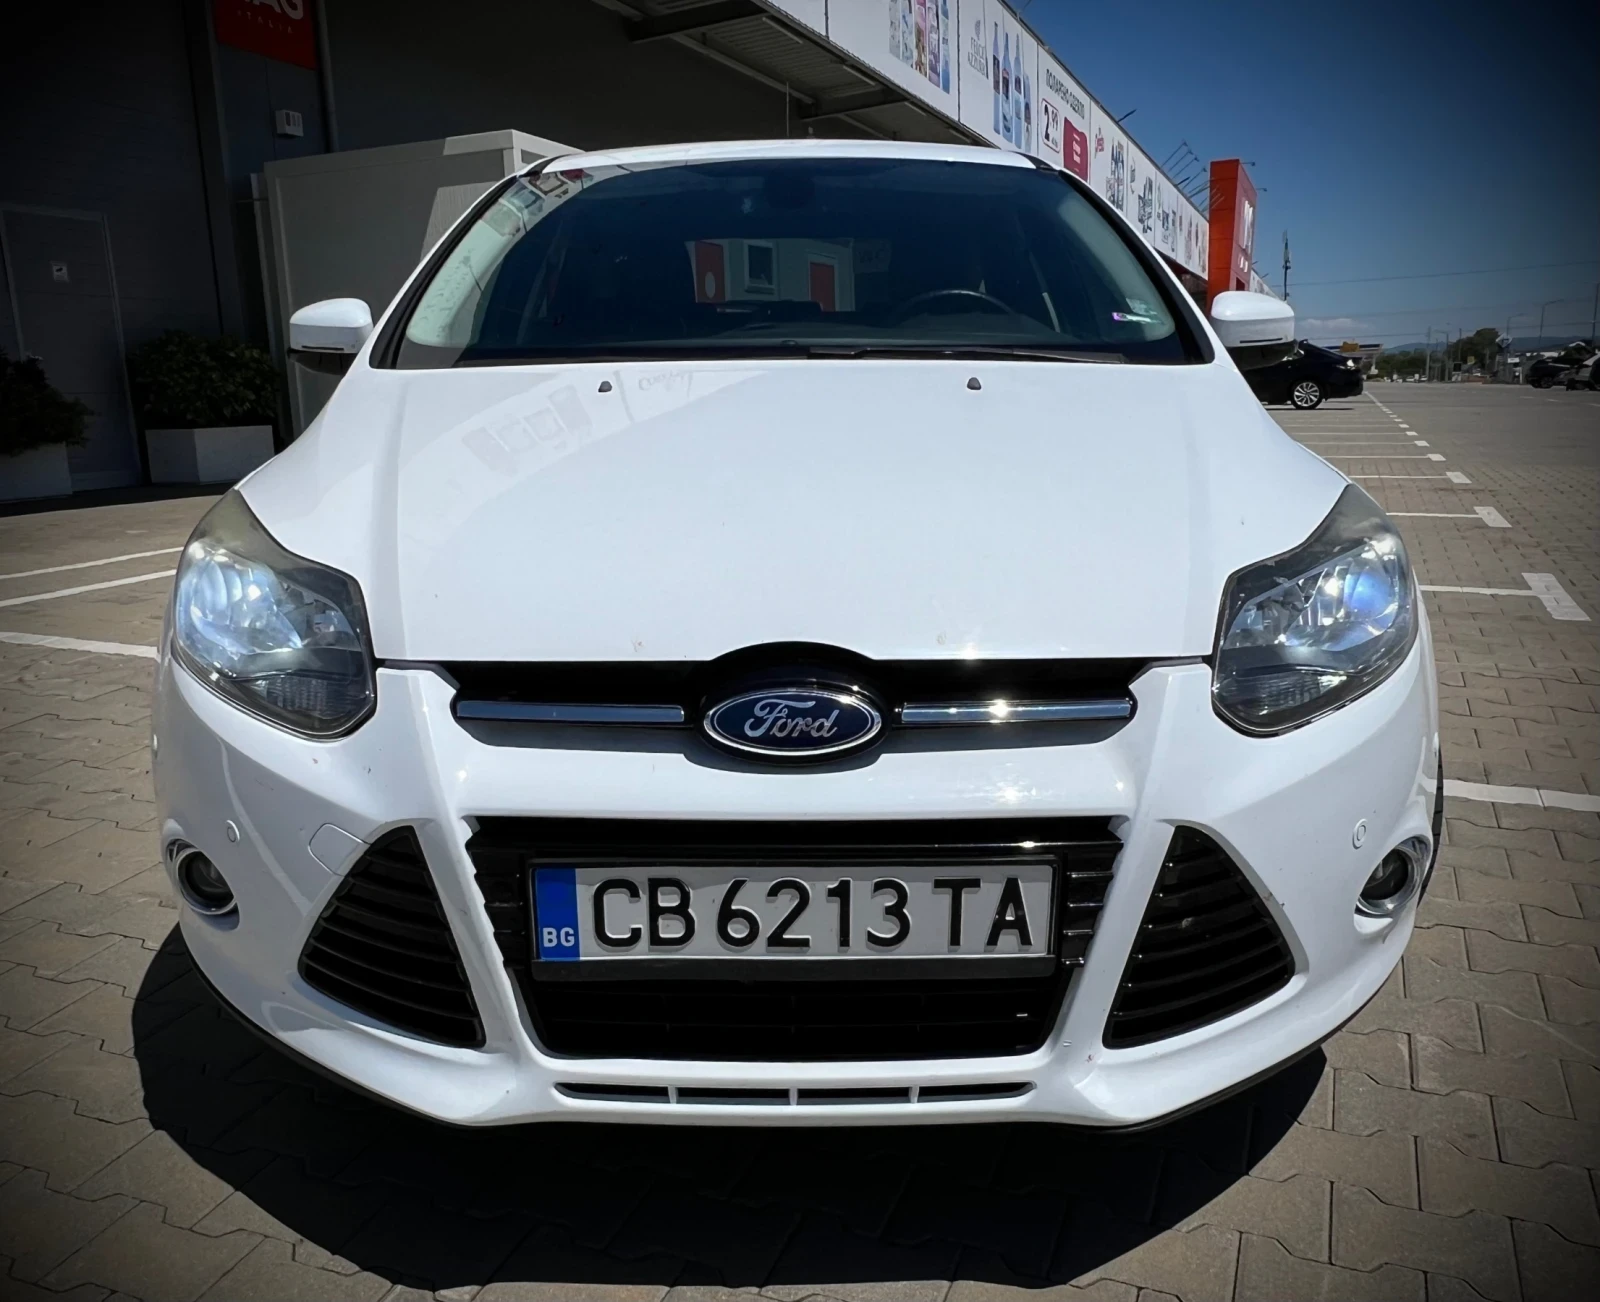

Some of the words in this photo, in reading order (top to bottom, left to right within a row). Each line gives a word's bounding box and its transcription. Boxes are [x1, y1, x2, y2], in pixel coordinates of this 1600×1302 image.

[743, 698, 840, 737] Ford
[593, 877, 697, 949] CB
[716, 877, 911, 949] 6213
[933, 877, 1034, 949] TA
[542, 927, 576, 949] BG
